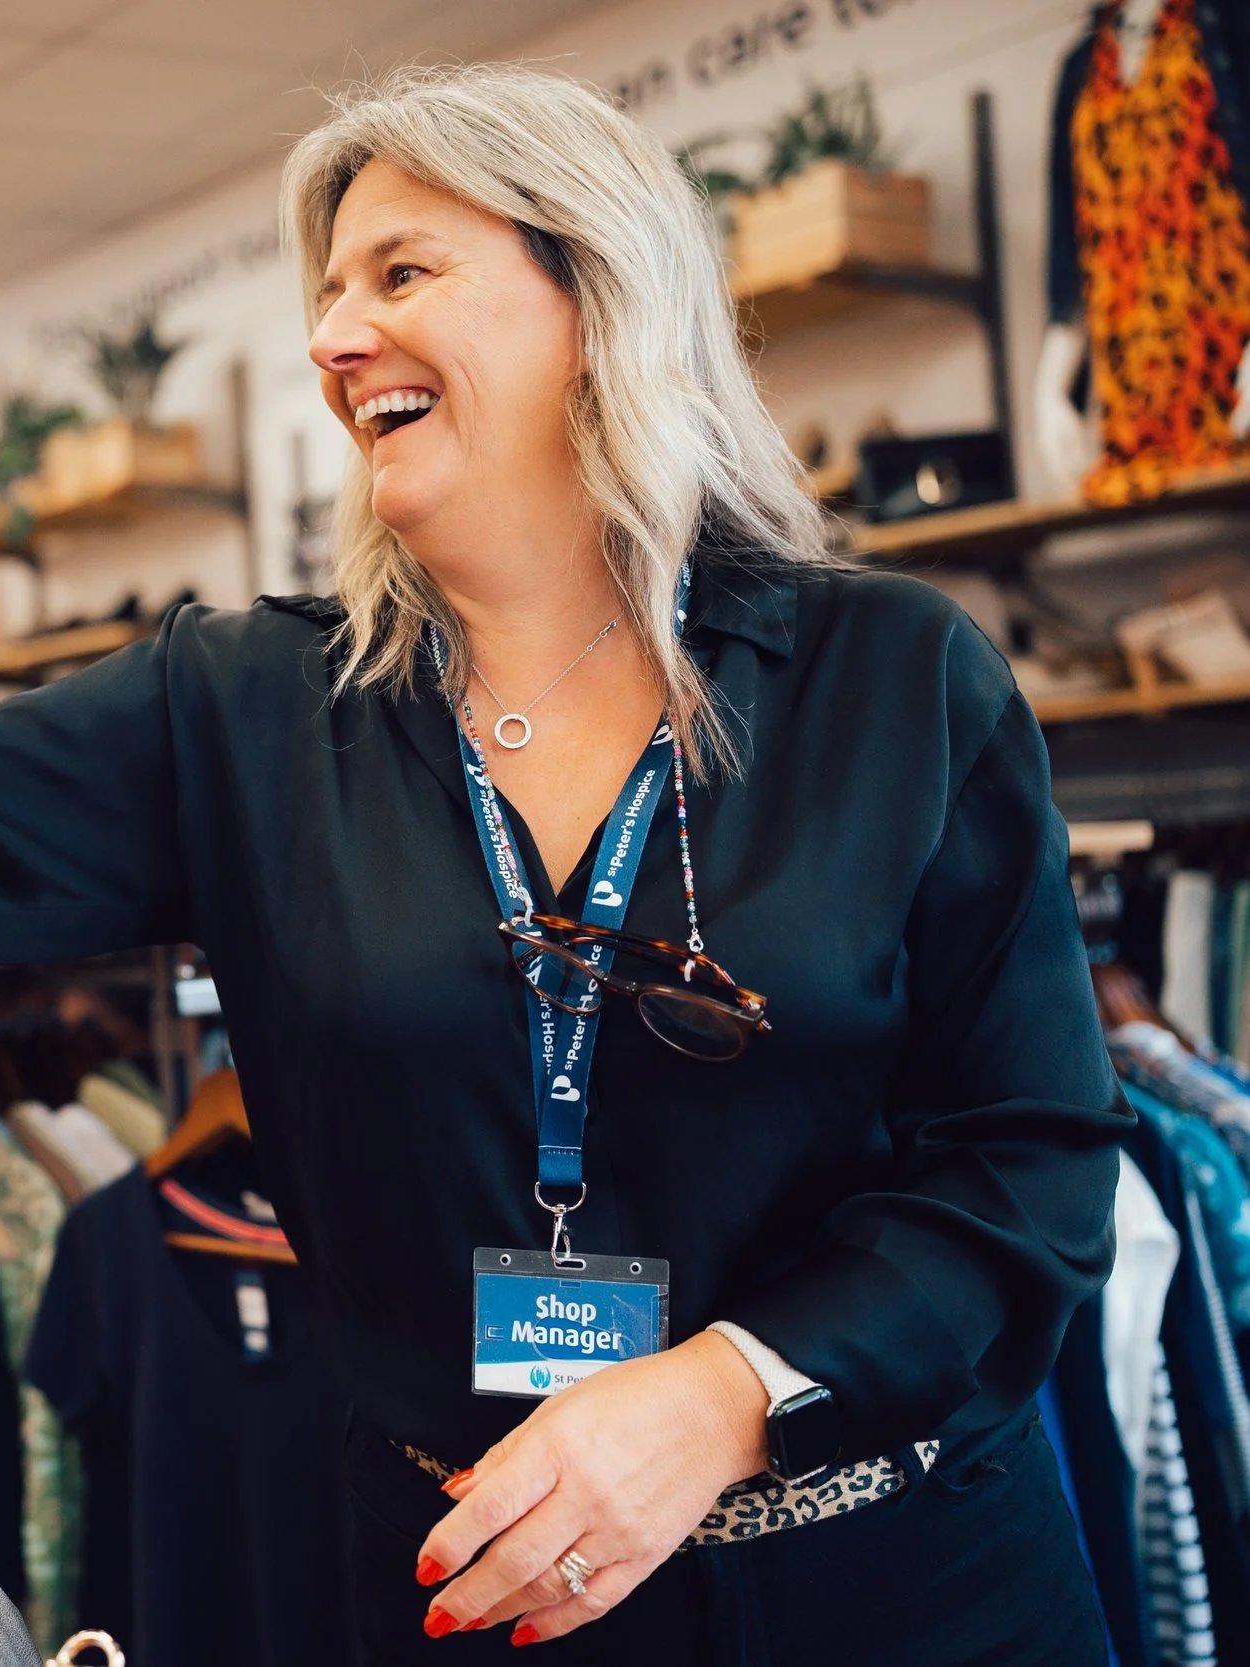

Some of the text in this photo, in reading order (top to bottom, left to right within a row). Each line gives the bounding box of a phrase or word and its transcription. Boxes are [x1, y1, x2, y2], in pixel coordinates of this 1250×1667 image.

[685, 1, 816, 89] care
[610, 818, 636, 868] Peter's
[625, 768, 656, 818] Hospice
[493, 843, 518, 899] Hospice
[567, 1013, 588, 1061] Peter'
[535, 1293, 597, 1328] Shop
[511, 1320, 622, 1355] Manager
[554, 1374, 564, 1384] St
